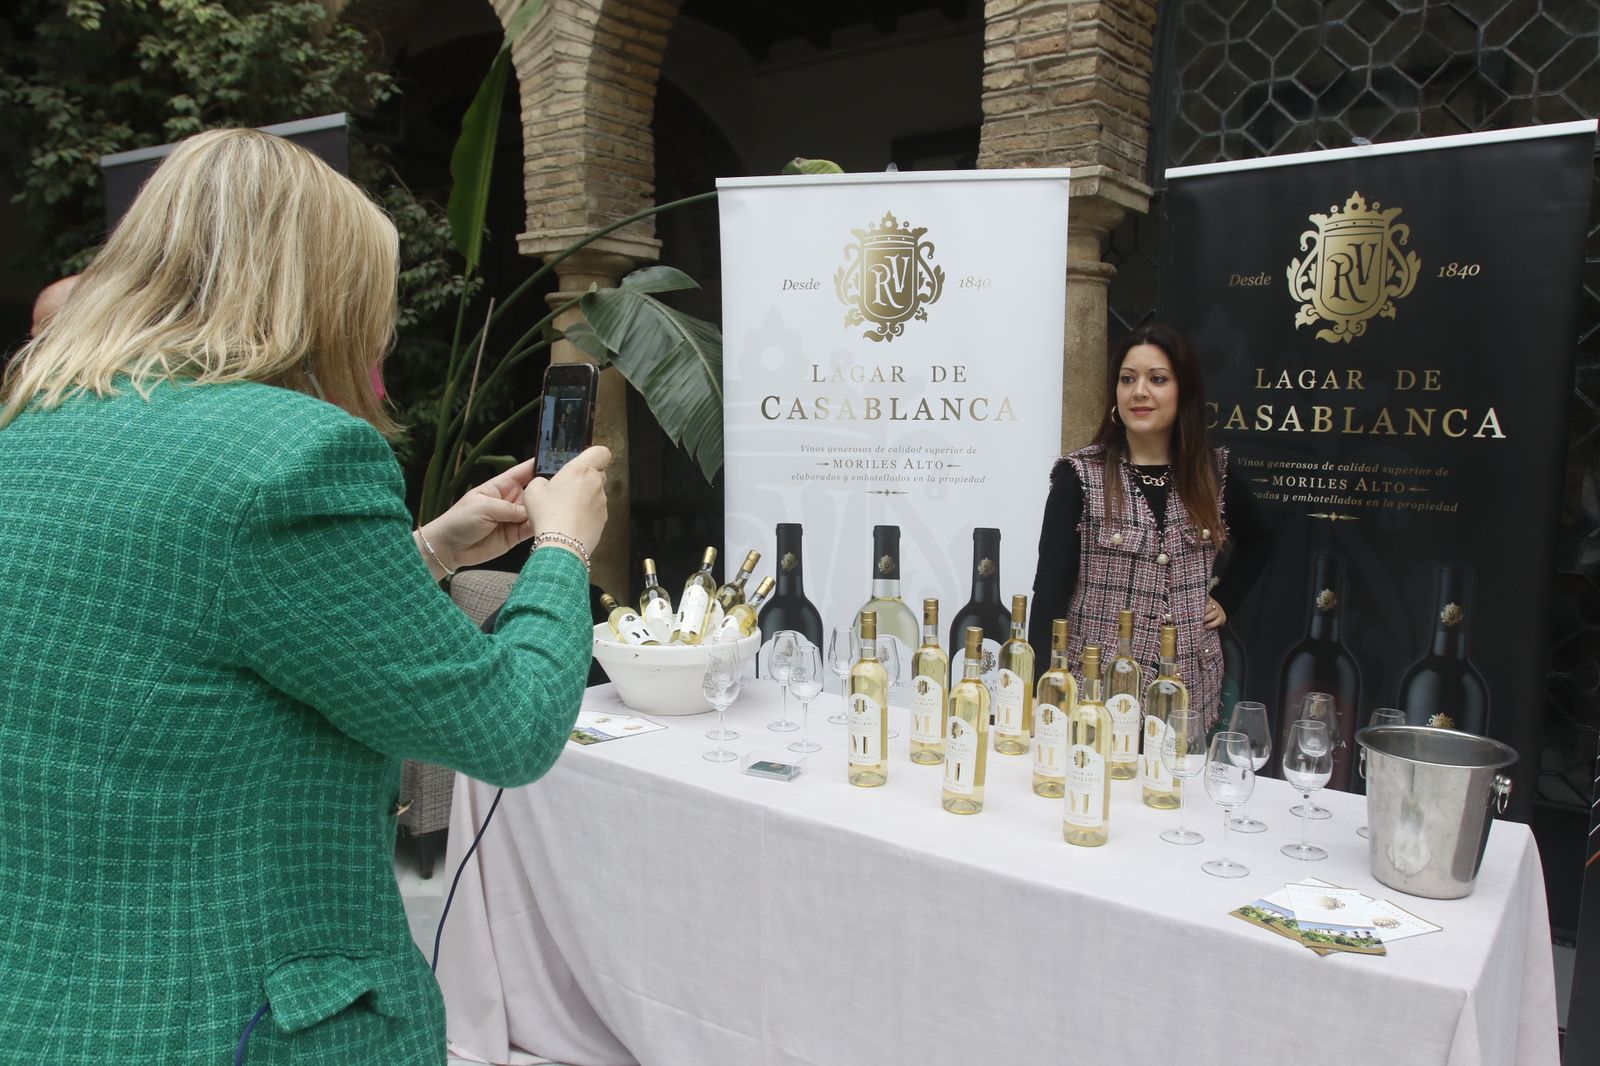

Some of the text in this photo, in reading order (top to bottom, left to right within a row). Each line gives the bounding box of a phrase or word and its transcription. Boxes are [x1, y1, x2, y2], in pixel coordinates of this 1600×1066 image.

[1436, 263, 1481, 279] 1840
[781, 278, 821, 291] Desde
[958, 276, 992, 289] 1840
[1228, 272, 1272, 287] Desde
[811, 364, 967, 384] LAGAR DE
[1254, 368, 1442, 391] LAGAR DE
[760, 395, 1020, 421] CASABLANCA
[799, 444, 977, 456] Vinos generosos de calidad superior de
[832, 459, 898, 469] MORILES
[1237, 457, 1449, 477] Vinos generosos de calidad superior de
[791, 473, 841, 481] elaborados
[843, 475, 849, 483] y
[851, 473, 910, 482] embotellados
[927, 474, 936, 483] la
[938, 474, 986, 485] propiedad
[1272, 475, 1348, 490] MORILES
[1282, 494, 1290, 503] y
[1292, 493, 1363, 506] embotellados
[1366, 499, 1380, 508] en
[1382, 498, 1394, 509] la
[1396, 499, 1458, 513] propiedad
